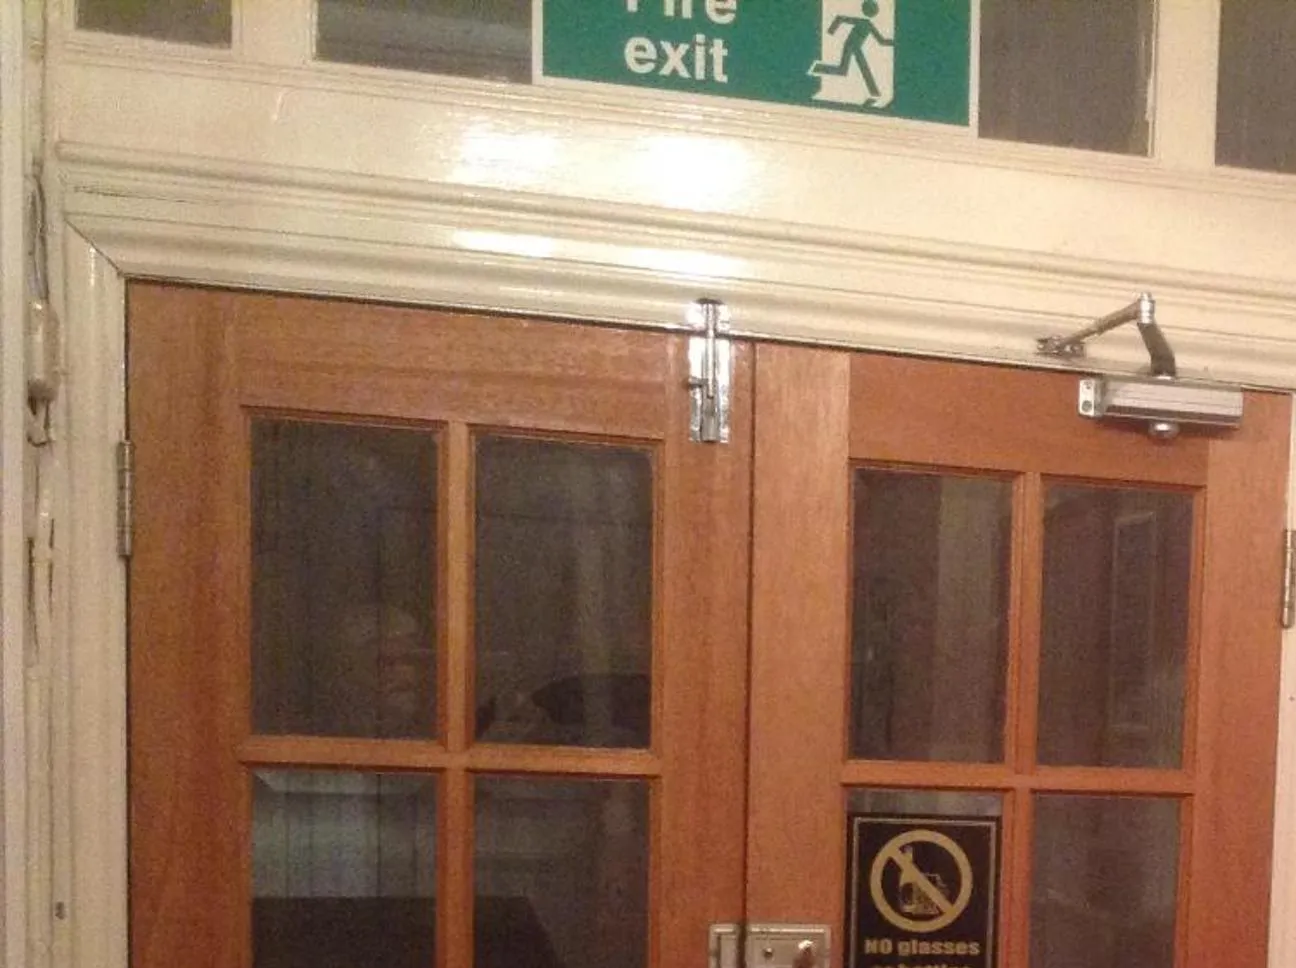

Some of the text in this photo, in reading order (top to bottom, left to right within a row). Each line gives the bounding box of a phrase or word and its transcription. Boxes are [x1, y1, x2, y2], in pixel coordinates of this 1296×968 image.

[626, 0, 738, 24] re
[623, 33, 729, 84] exit
[898, 939, 981, 956] glasses
